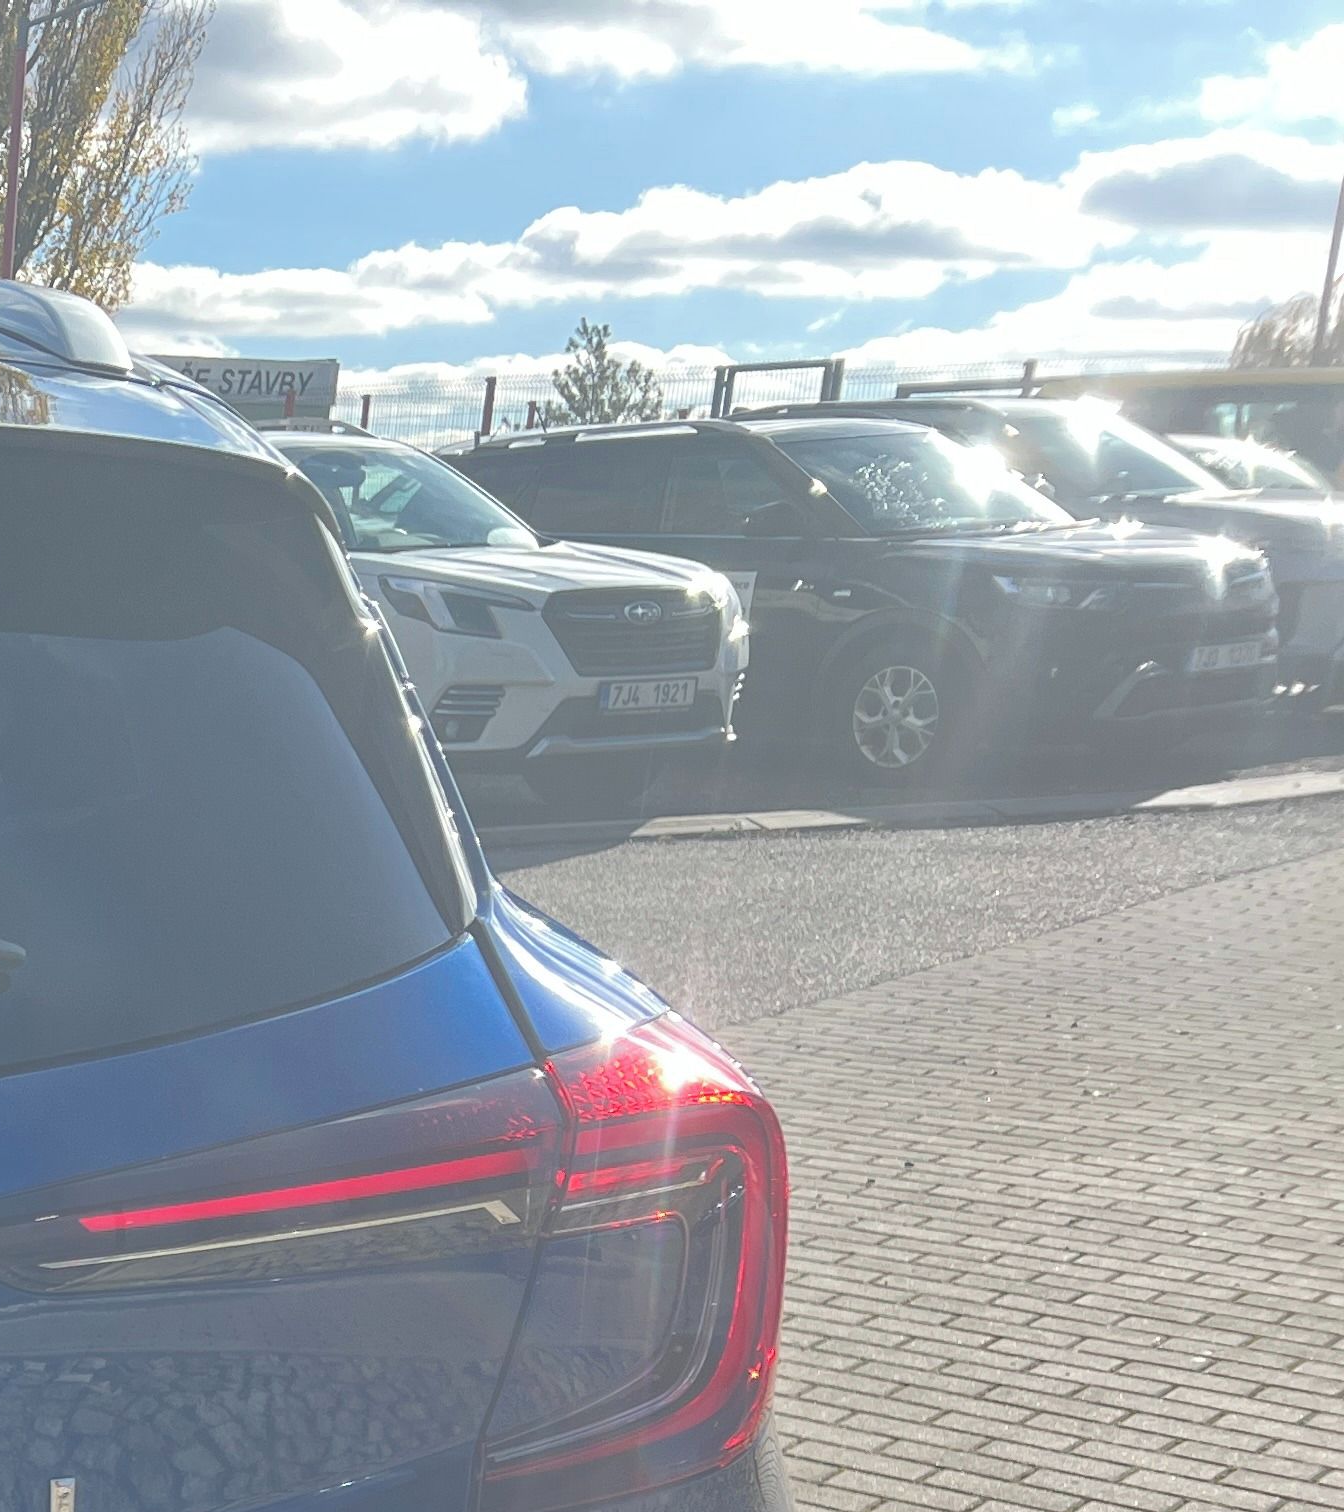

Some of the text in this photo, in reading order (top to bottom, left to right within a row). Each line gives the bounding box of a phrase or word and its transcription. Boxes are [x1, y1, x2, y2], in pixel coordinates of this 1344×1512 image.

[218, 368, 314, 396] STAVBY
[611, 681, 689, 706] 7J4 1921
